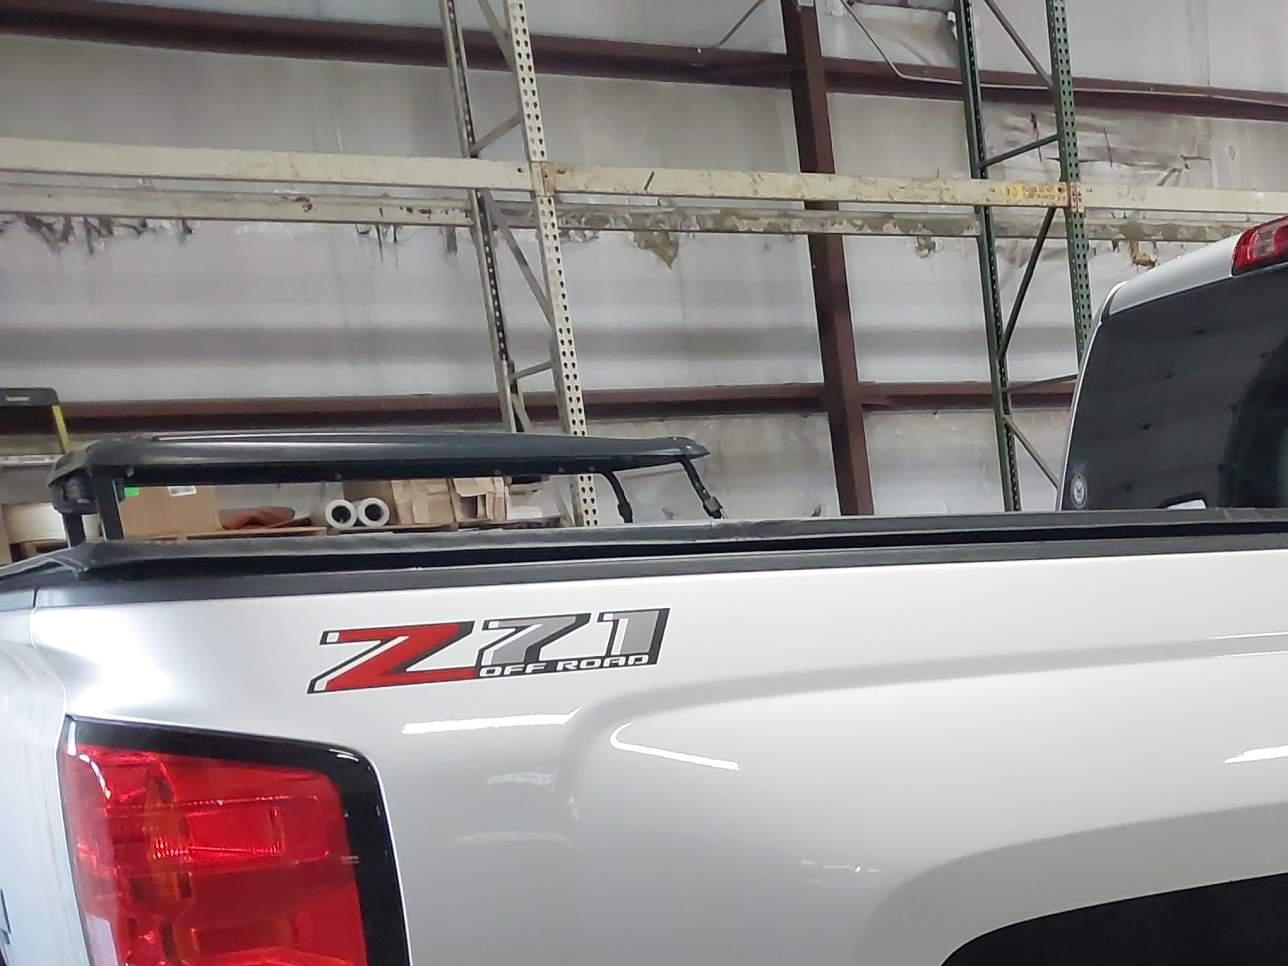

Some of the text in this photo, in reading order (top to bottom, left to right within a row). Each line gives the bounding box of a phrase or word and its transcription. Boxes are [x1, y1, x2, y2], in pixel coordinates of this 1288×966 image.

[307, 608, 671, 694] Z71
[479, 654, 649, 678] OFF ROAD
